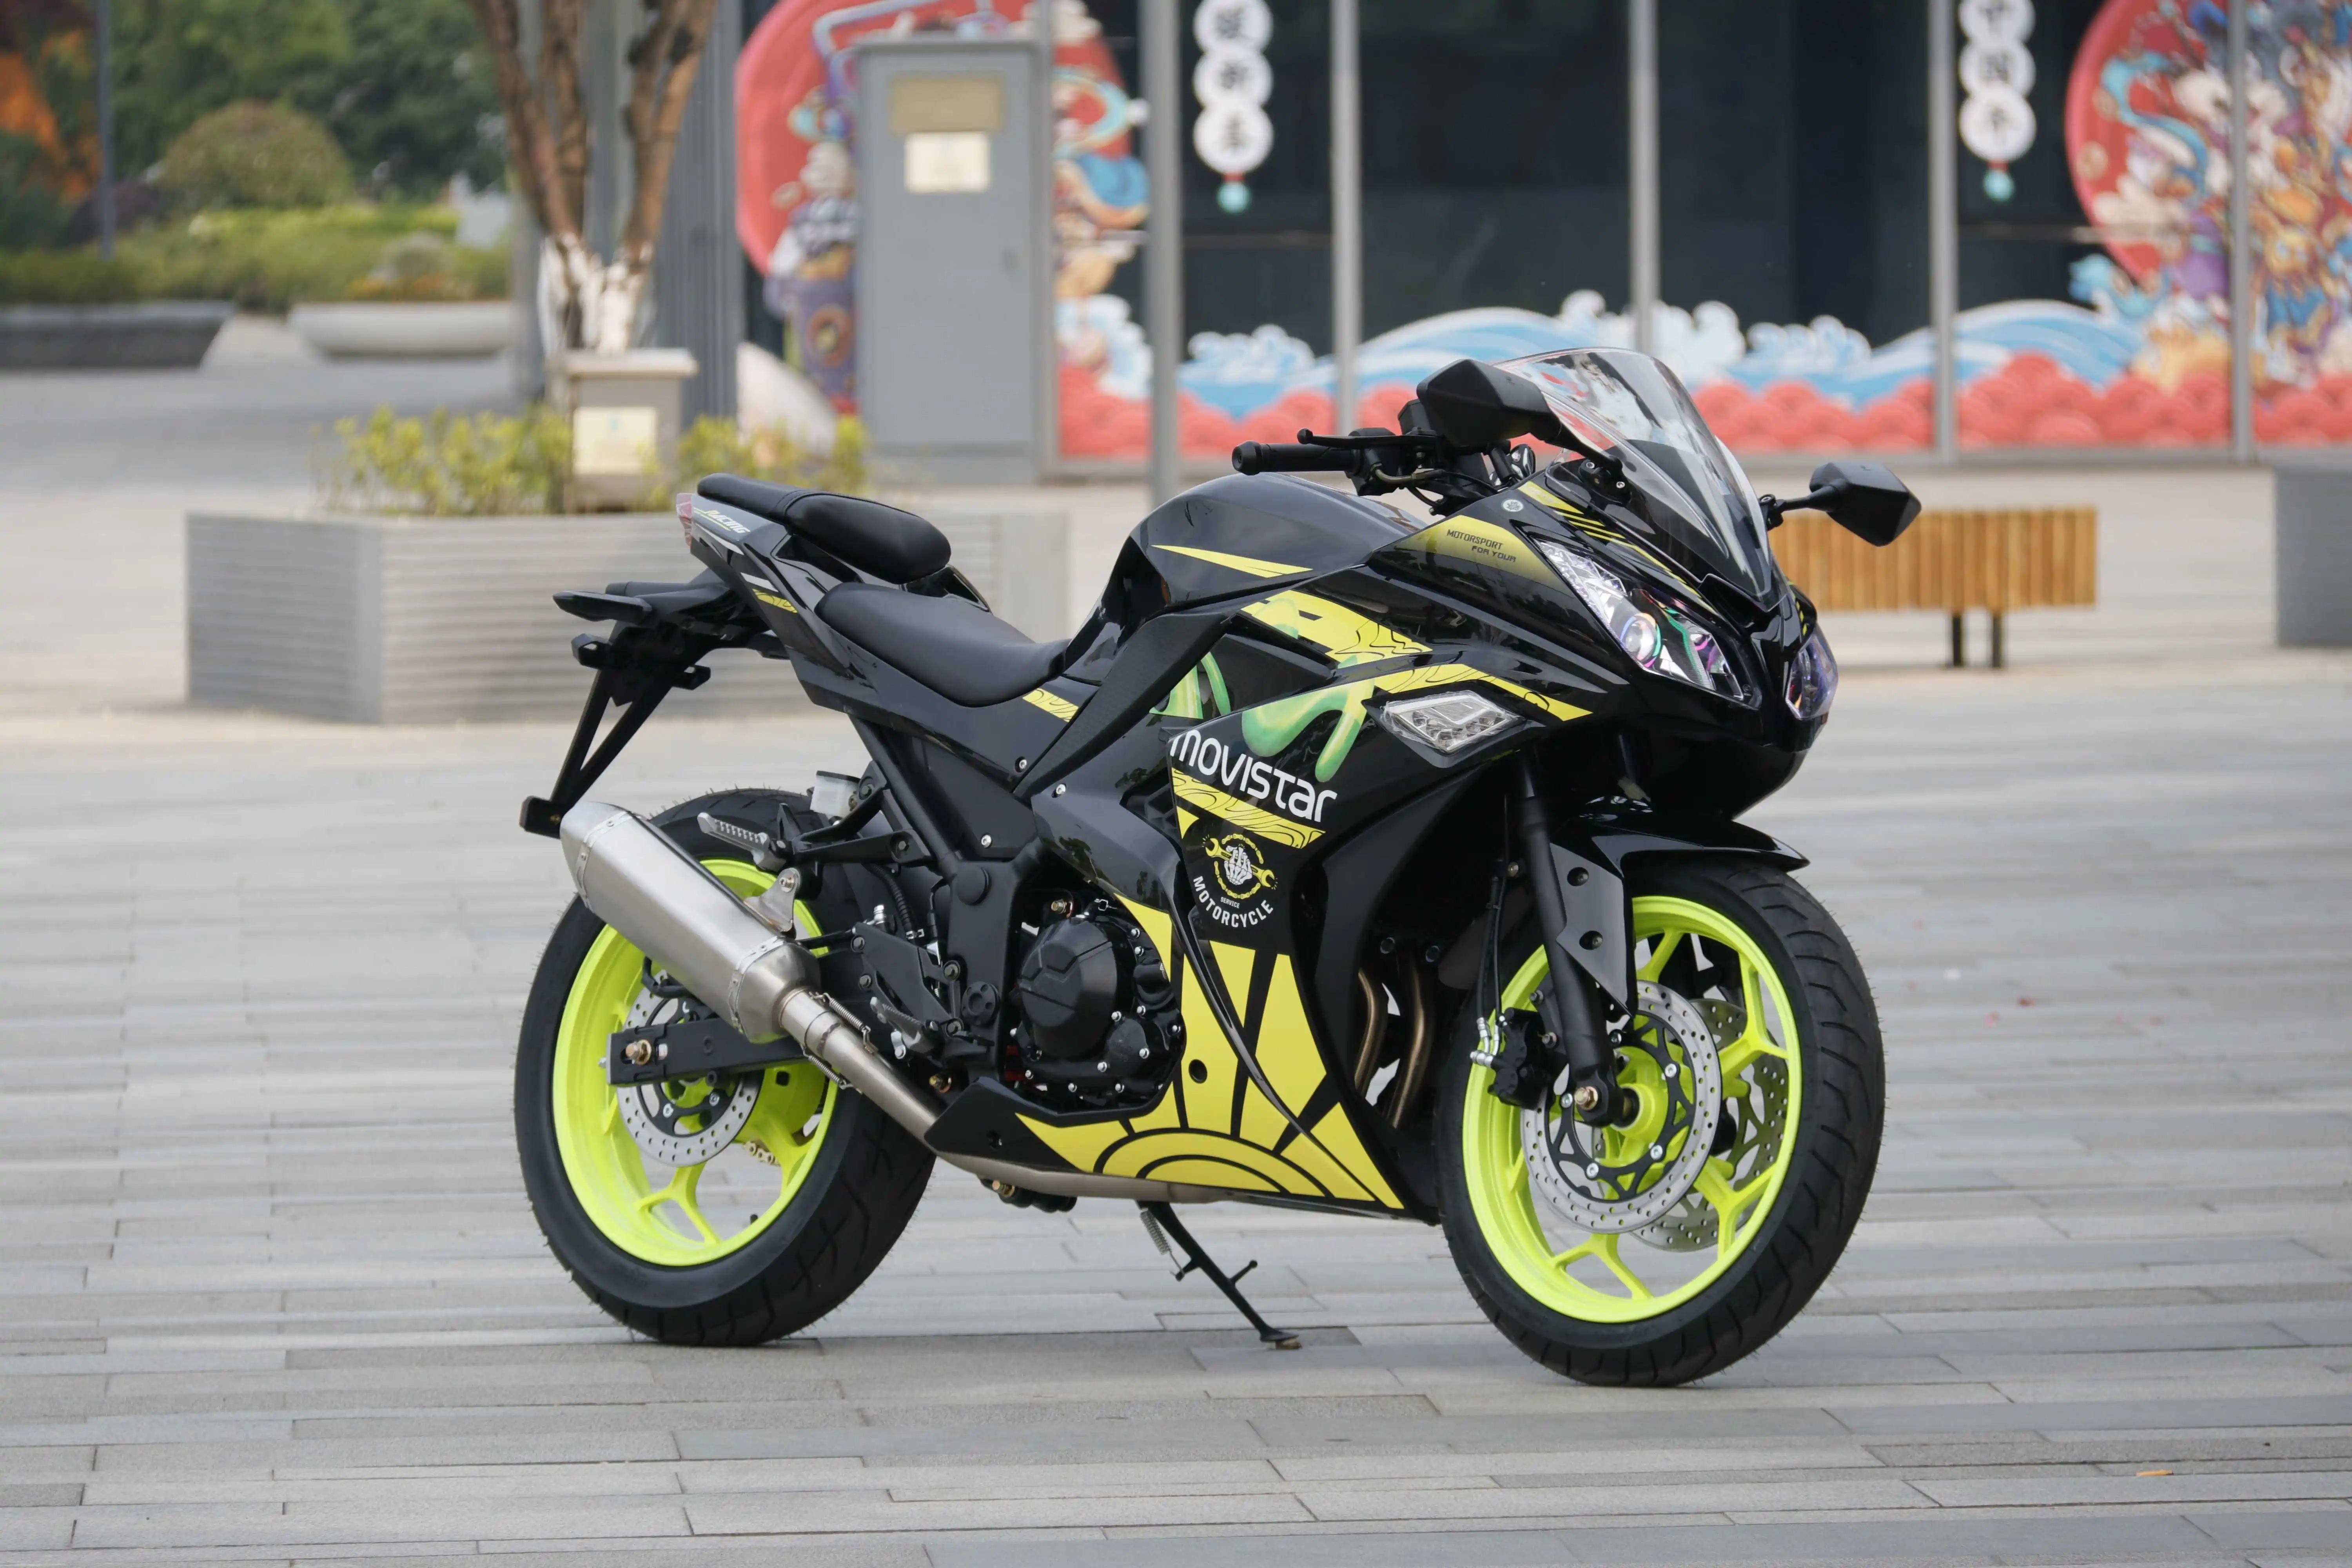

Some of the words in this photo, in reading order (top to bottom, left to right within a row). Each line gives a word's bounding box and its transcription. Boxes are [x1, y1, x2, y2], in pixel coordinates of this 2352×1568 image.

[1446, 529, 1504, 550] MOTORSPORT
[1471, 545, 1490, 555] FOR
[1492, 550, 1517, 563] YOUR
[1193, 875, 1274, 928] MOTORCYCLE
[1220, 897, 1240, 909] SERVICE
